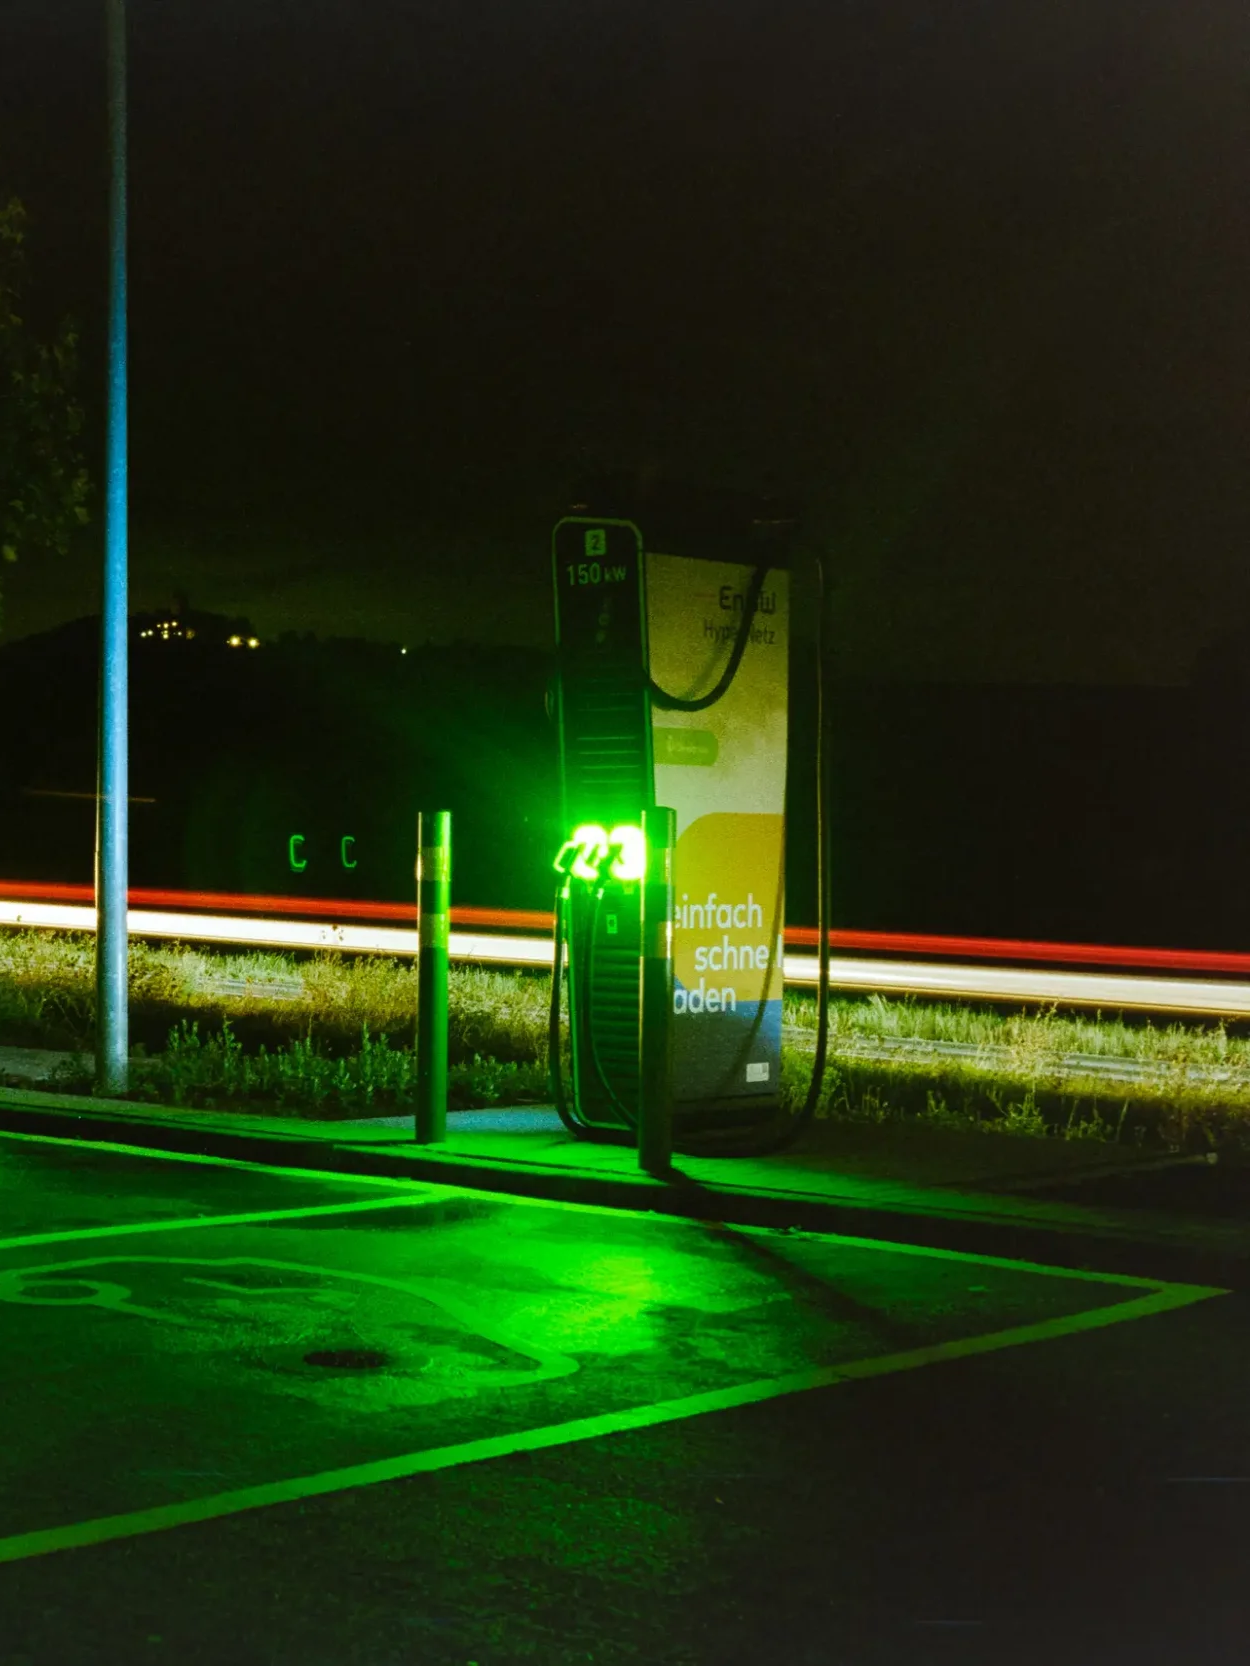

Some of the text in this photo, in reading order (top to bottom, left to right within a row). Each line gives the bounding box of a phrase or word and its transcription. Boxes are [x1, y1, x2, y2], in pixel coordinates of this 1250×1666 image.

[566, 562, 601, 586] 150
[719, 585, 776, 614] EnW
[694, 935, 783, 973] schnel
[673, 978, 737, 1014] aden
